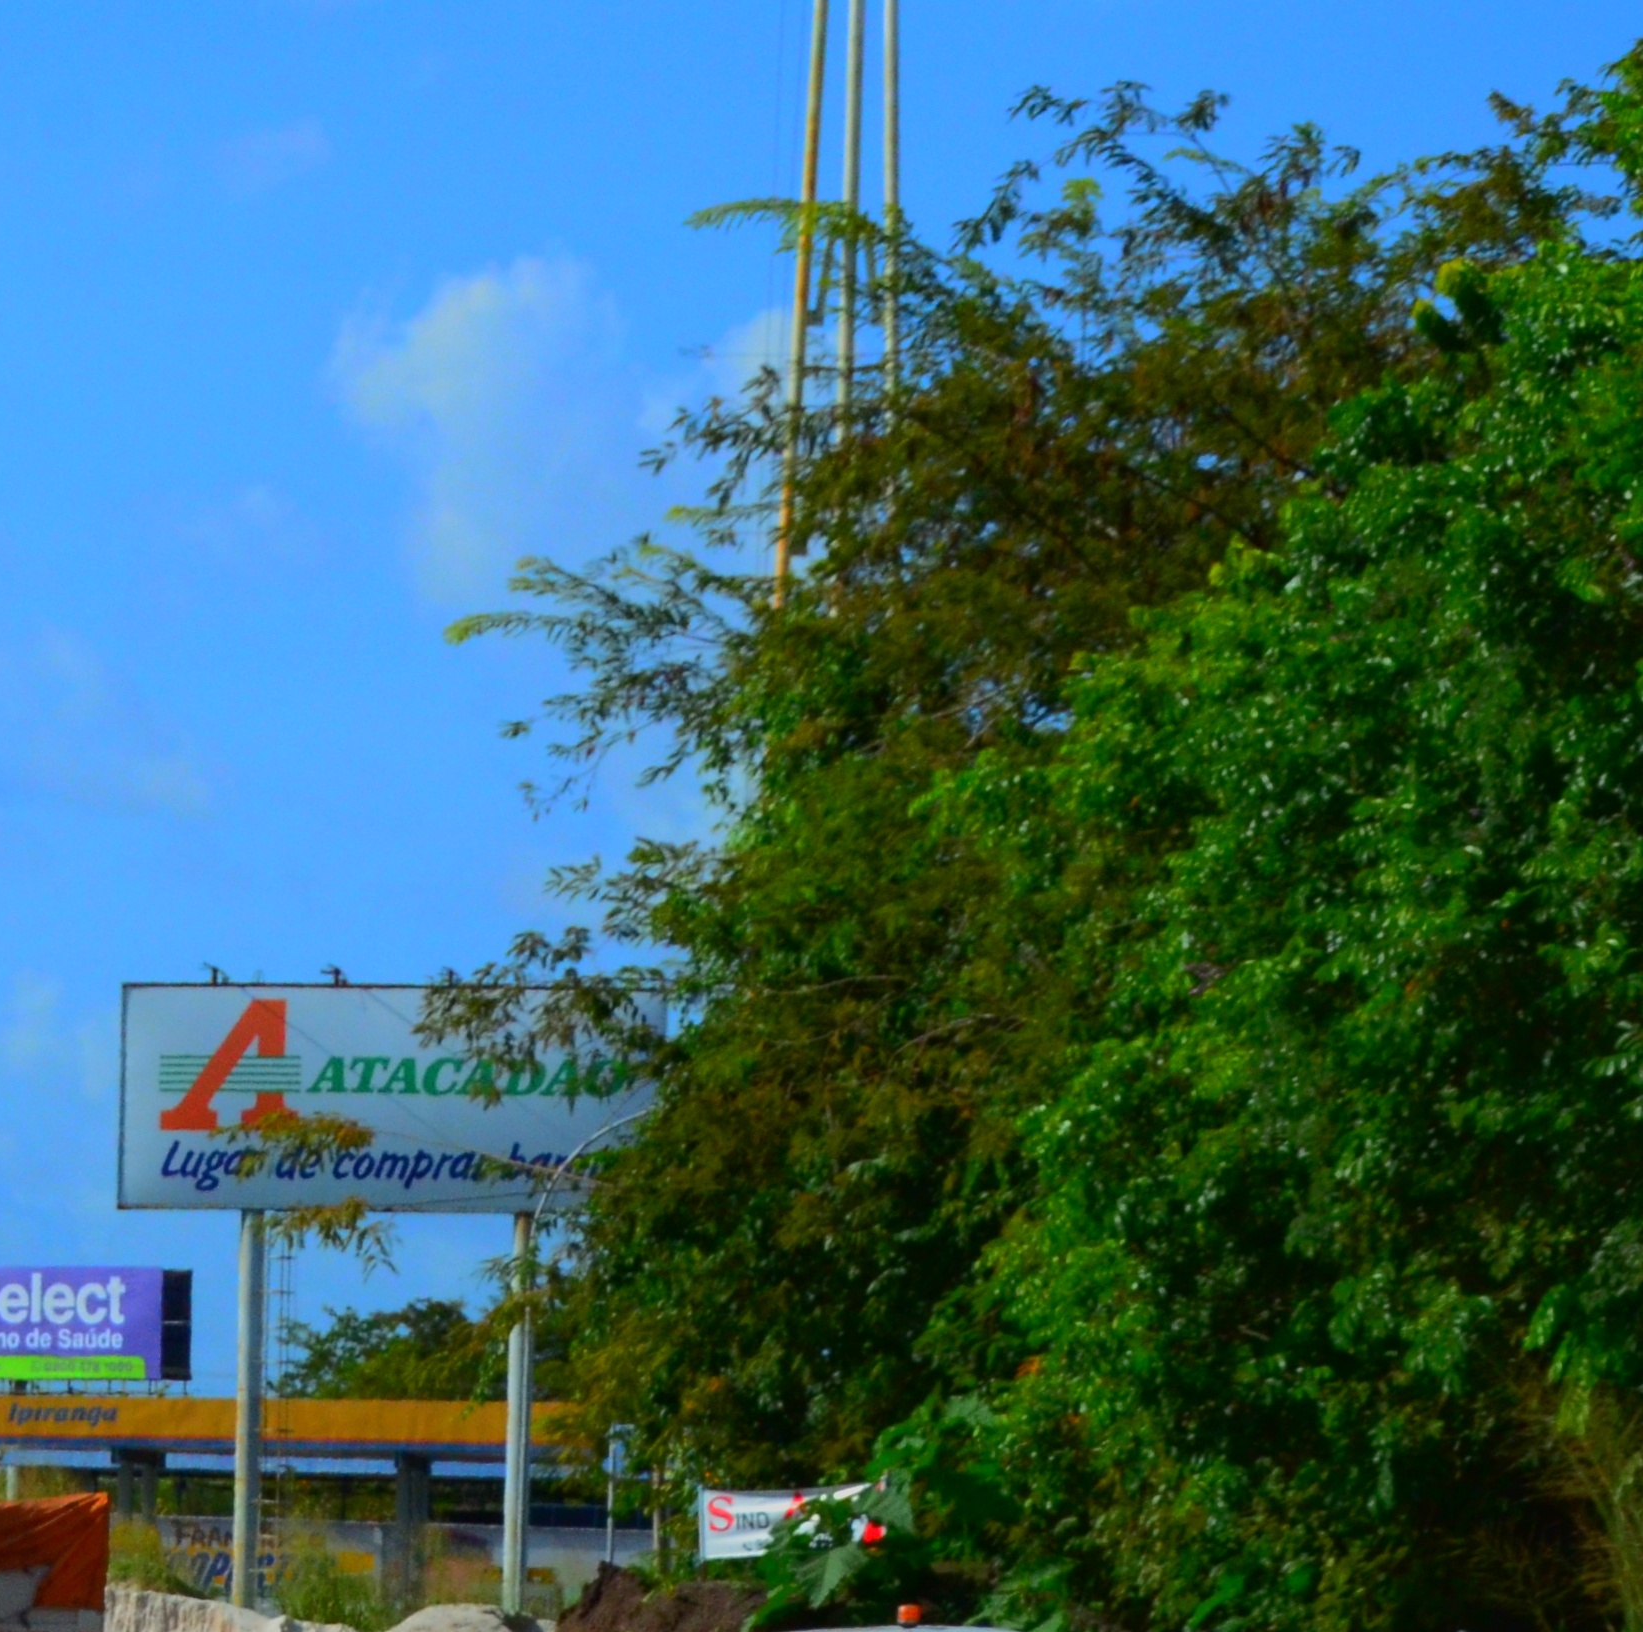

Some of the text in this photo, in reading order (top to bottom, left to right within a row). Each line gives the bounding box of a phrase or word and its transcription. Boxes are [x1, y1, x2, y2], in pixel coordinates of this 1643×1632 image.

[25, 1328, 51, 1349] de
[58, 1327, 124, 1349] Saúde
[9, 1403, 118, 1427] Ipiranga
